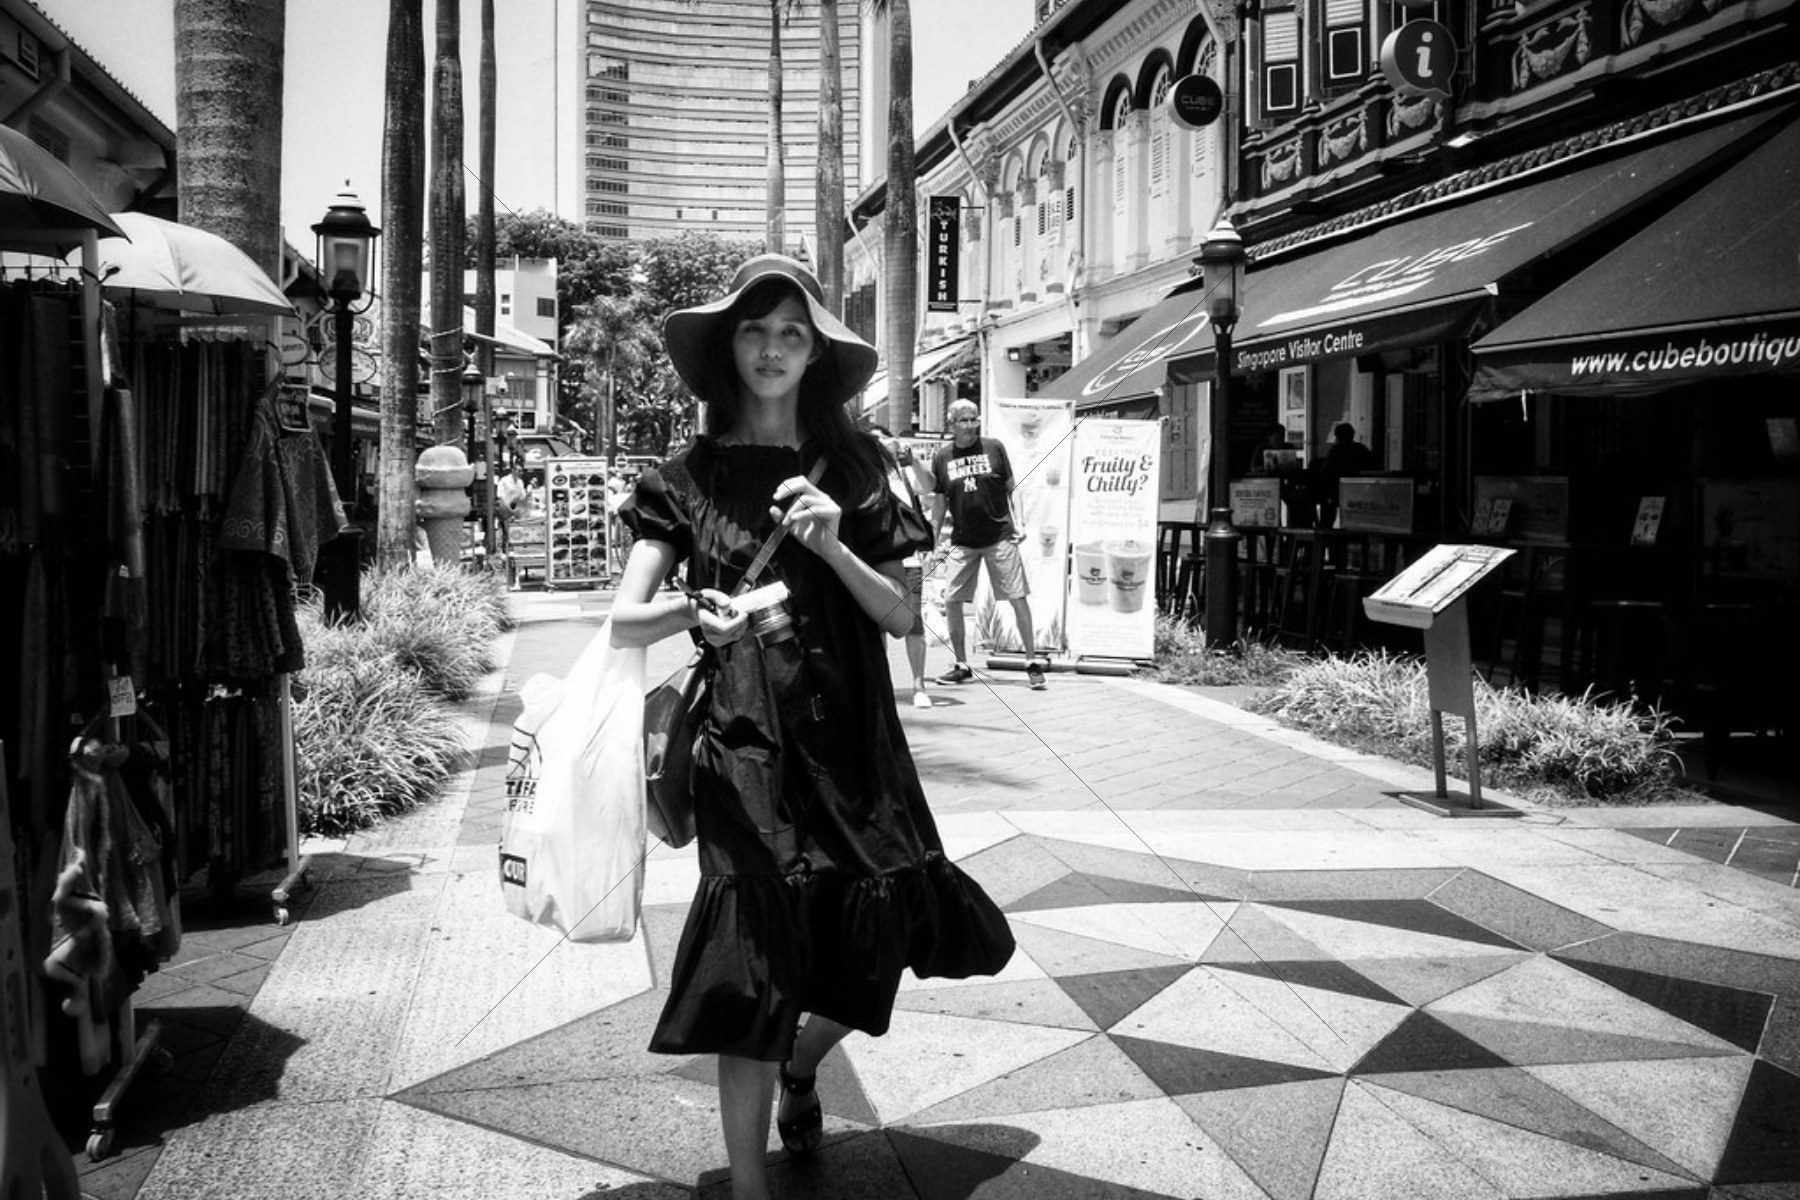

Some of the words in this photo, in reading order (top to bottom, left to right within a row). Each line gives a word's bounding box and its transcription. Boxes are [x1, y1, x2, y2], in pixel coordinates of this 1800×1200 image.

[937, 220, 949, 302] TURKISH
[1236, 346, 1286, 371] Singapore
[1288, 337, 1322, 359] Visitor
[1323, 329, 1364, 354] Centre
[1080, 455, 1137, 478] Fruity
[1138, 454, 1154, 472] &
[1086, 473, 1149, 498] Chilly?
